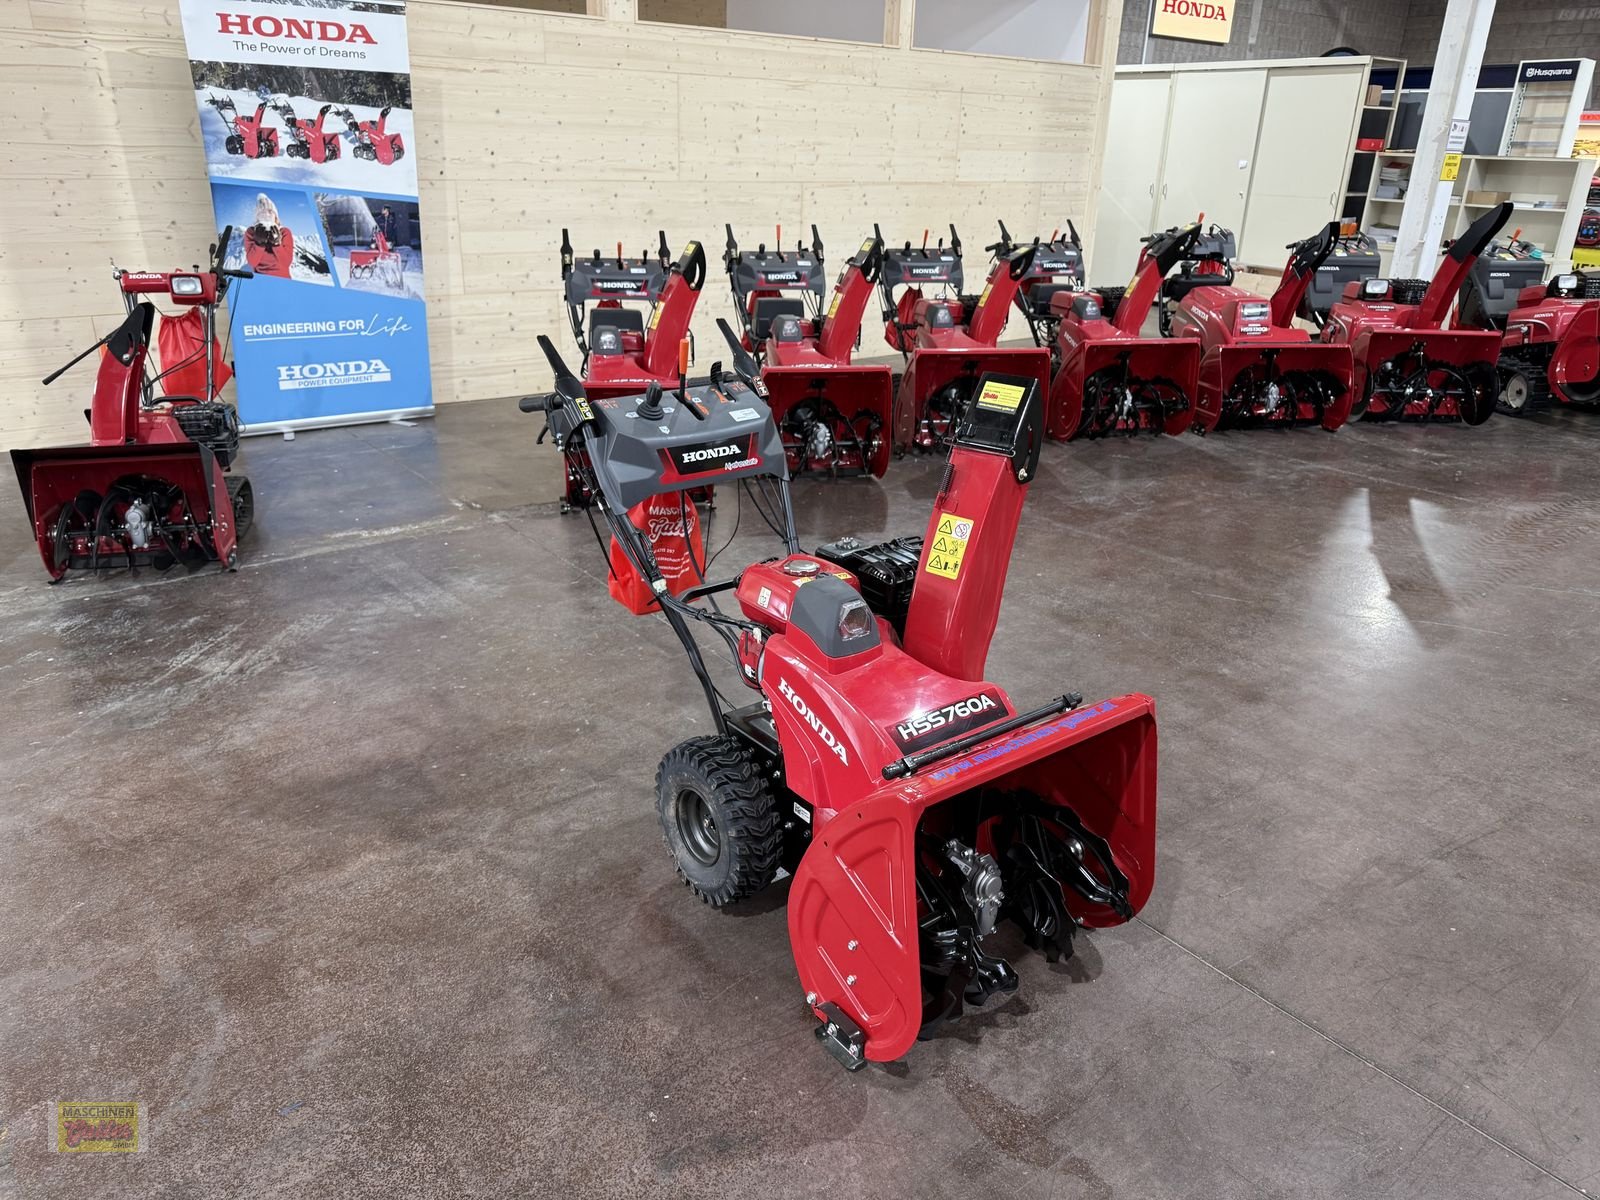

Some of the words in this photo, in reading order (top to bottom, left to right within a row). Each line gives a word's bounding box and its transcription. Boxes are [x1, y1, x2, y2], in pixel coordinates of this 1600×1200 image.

[1162, 0, 1226, 21] HONDA
[216, 13, 378, 44] HONDA
[233, 40, 257, 52] The
[260, 42, 301, 55] Power
[303, 46, 317, 56] of
[319, 46, 366, 59] Dreams
[1534, 68, 1572, 76] Husqvarna
[913, 266, 939, 274] HONDA
[603, 281, 637, 289] HONDA
[244, 321, 336, 336] ENGINEERING
[339, 319, 365, 331] FOR
[360, 313, 412, 337] Life
[277, 359, 391, 380] HONDA
[329, 375, 374, 385] EQUIPMENT
[682, 444, 741, 463] HONDA
[778, 677, 848, 766] HONDA
[897, 694, 996, 740] HSS760A
